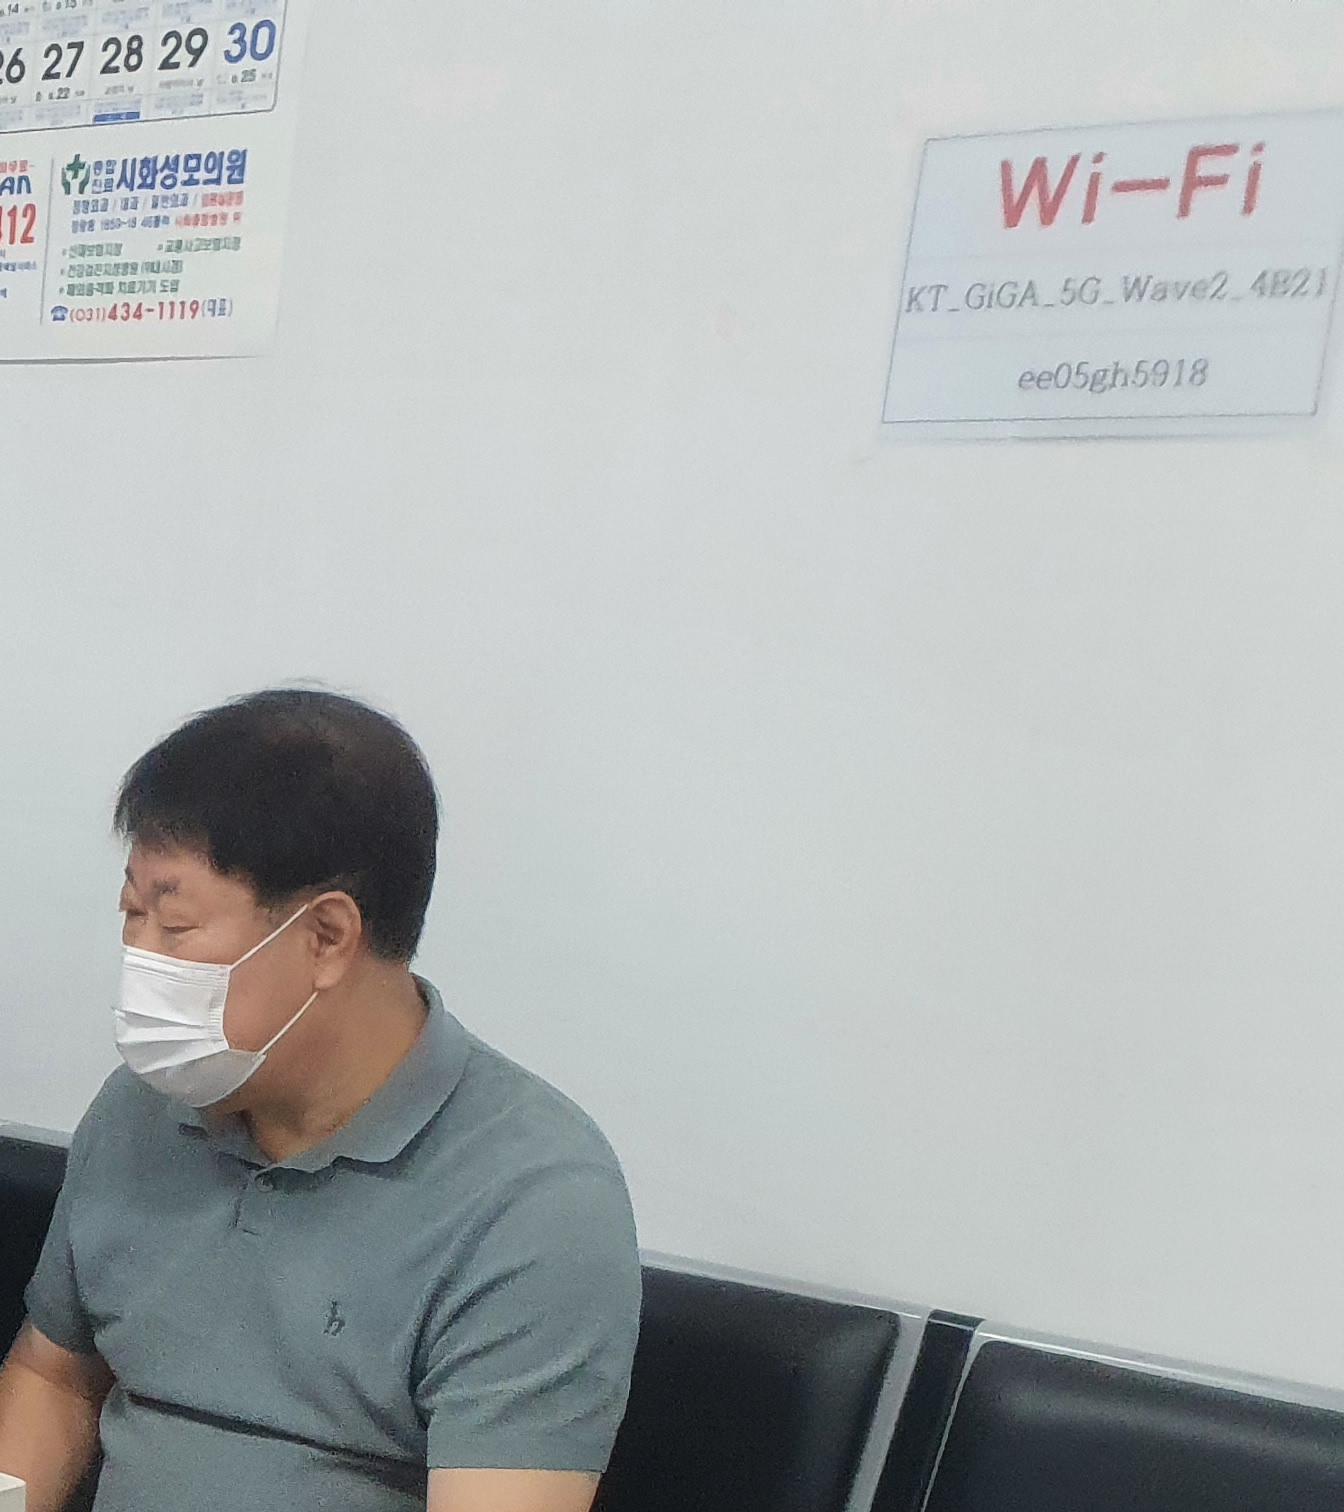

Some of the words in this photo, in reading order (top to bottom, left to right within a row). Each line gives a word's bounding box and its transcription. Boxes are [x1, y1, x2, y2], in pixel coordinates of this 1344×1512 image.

[41, 40, 85, 81] 27
[100, 34, 144, 75] 28
[158, 27, 209, 70] 29
[224, 19, 277, 64] 30
[116, 149, 248, 192] 시화성모의원
[999, 141, 1268, 230] Wi-Fi
[1017, 357, 1210, 394] ee05gh5918
